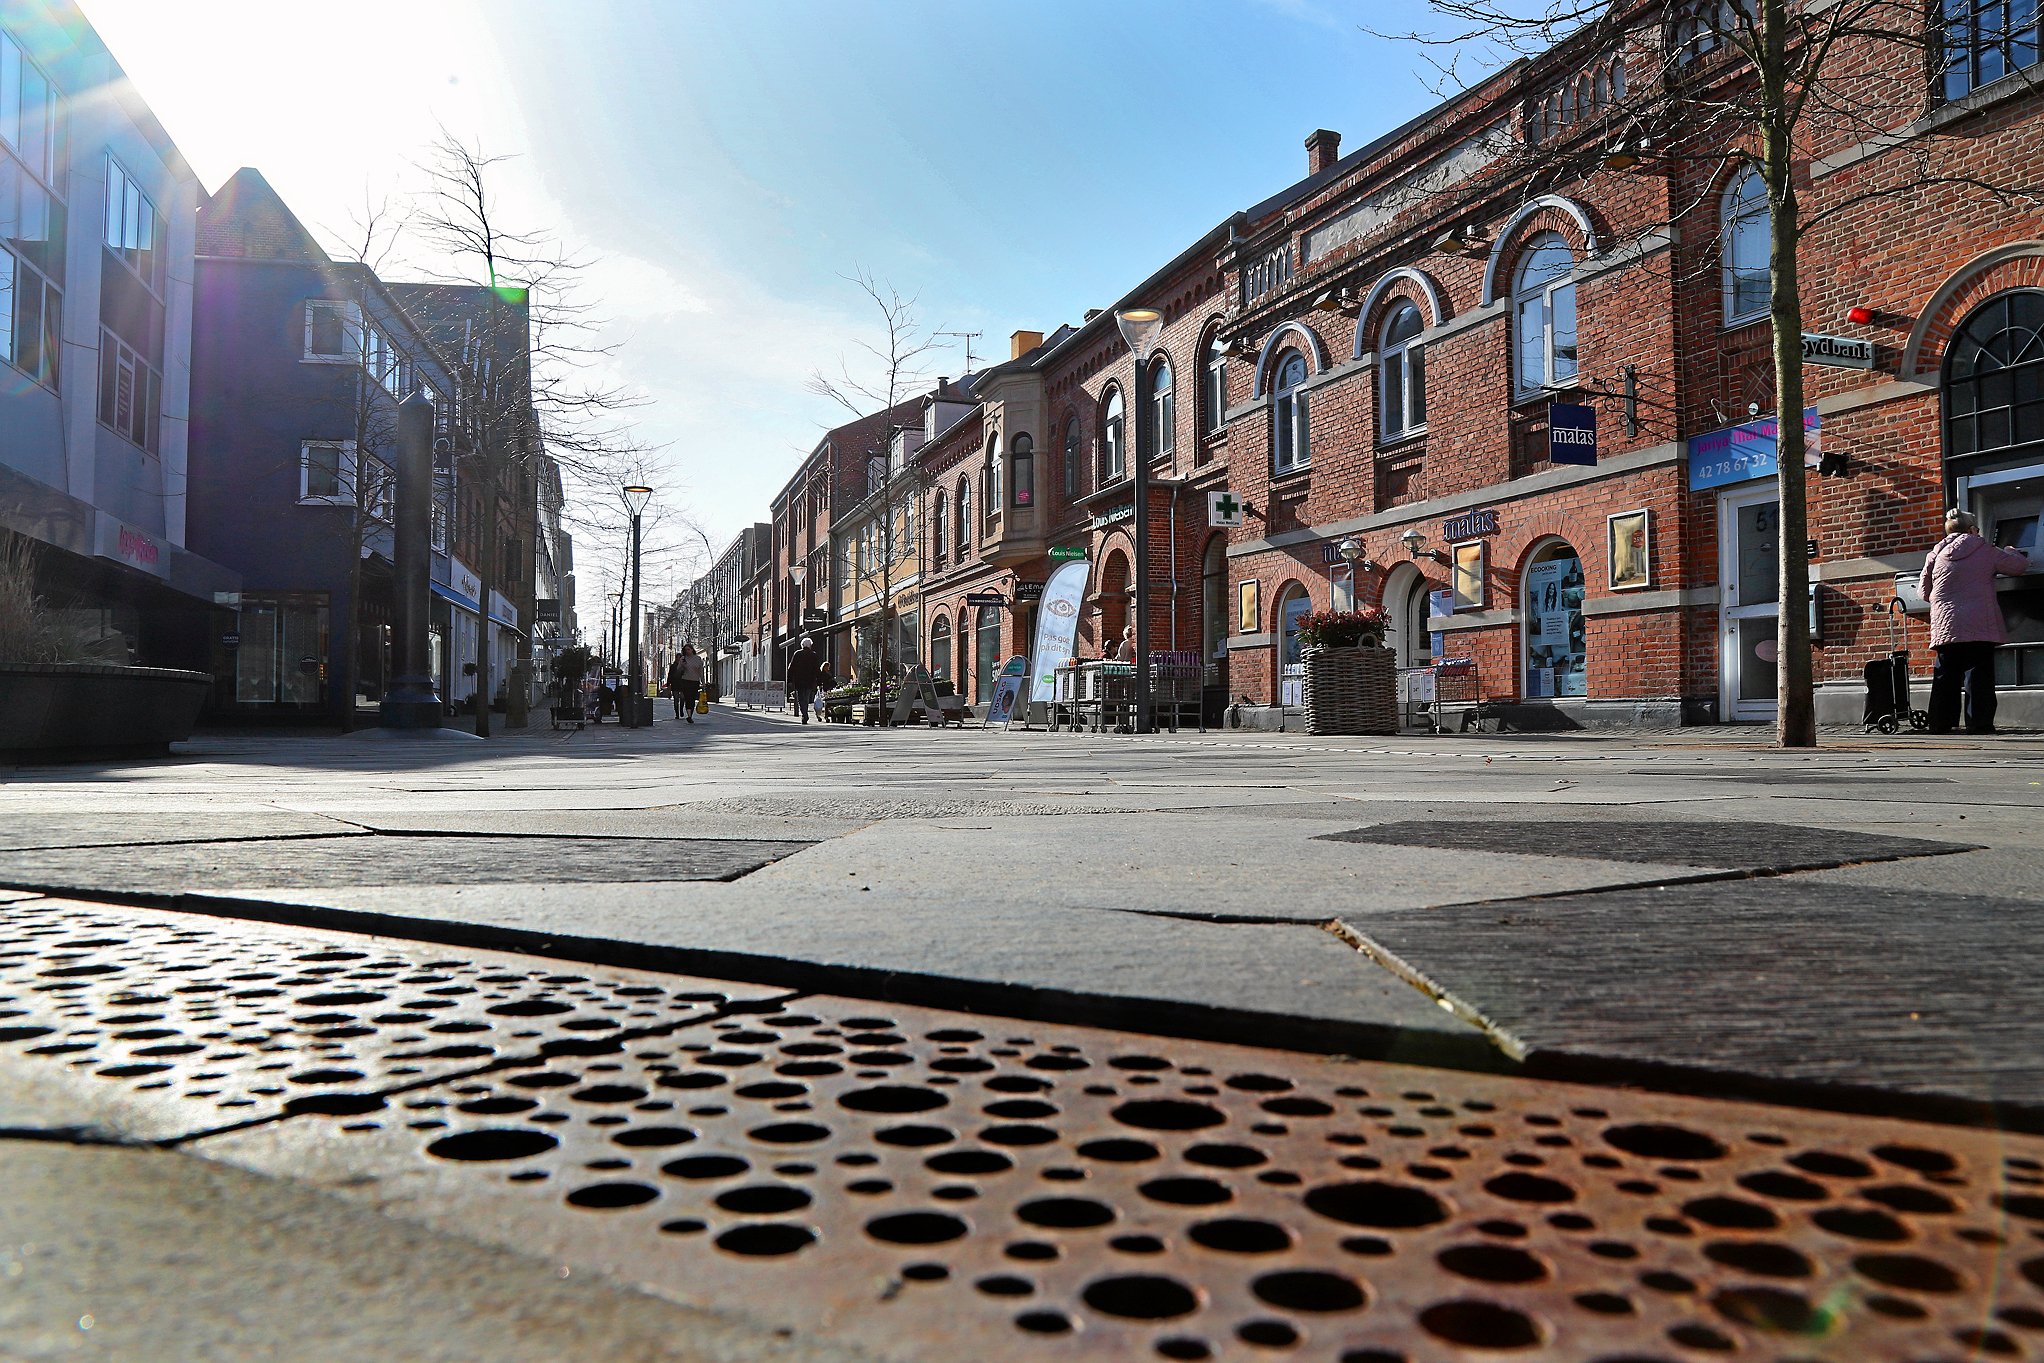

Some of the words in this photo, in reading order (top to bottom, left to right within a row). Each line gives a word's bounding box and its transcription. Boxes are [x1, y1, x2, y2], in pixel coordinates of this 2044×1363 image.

[1801, 336, 1870, 360] Sydbank
[1552, 425, 1595, 446] matas
[1734, 428, 1758, 445] Thai
[1699, 466, 1713, 479] 42
[1716, 461, 1730, 476] 78
[1733, 457, 1748, 472] 67
[1752, 453, 1768, 468] 32
[1443, 508, 1496, 542] matas
[1531, 564, 1557, 574] ECOOKING
[1043, 633, 1057, 641] Pas
[1050, 644, 1062, 652] dit
[992, 680, 1007, 715] UDSALG
